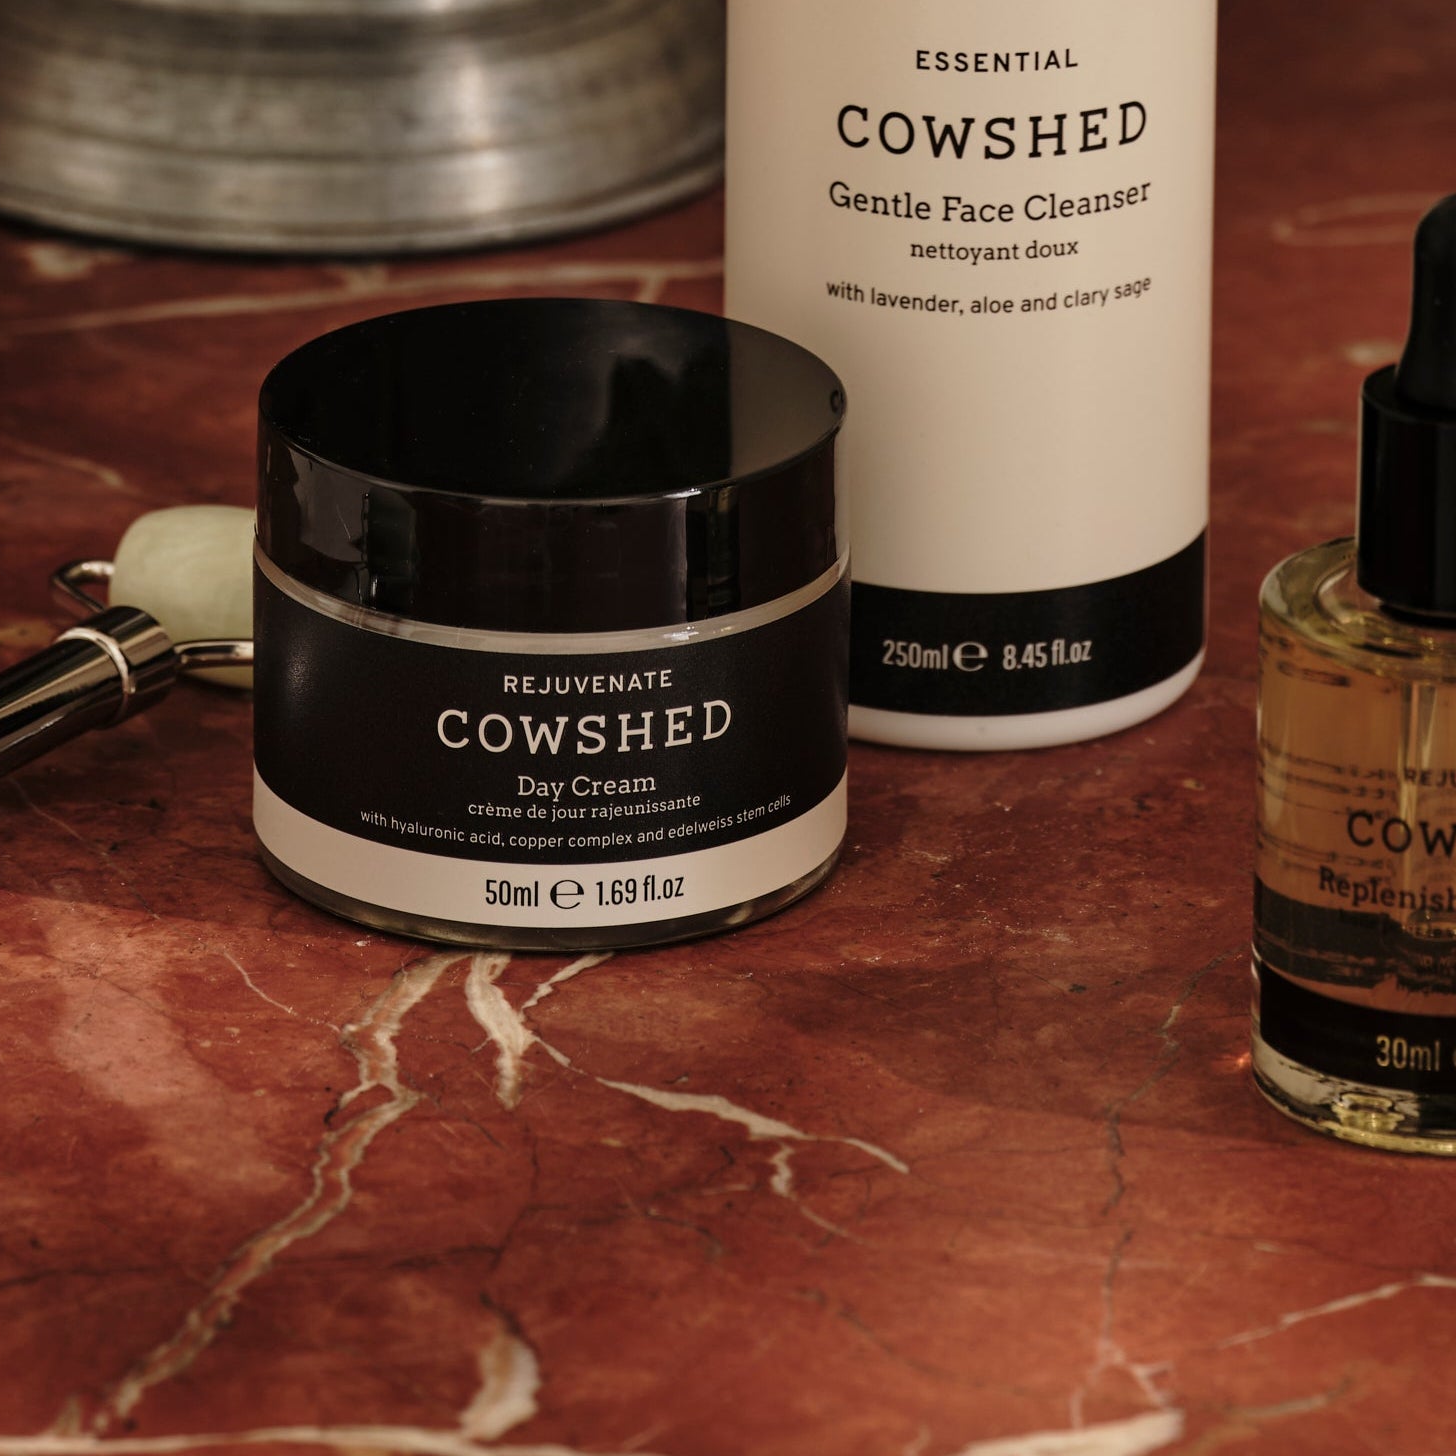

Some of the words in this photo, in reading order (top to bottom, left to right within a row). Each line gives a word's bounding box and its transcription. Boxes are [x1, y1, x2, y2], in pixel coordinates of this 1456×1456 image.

[916, 49, 1078, 73] ESSENTIAL
[837, 100, 1147, 160] COWSHED
[829, 181, 931, 220] Gentle
[942, 196, 1014, 222] Face
[1024, 182, 1151, 220] Cleanser
[910, 242, 1019, 265] nettoyant
[1025, 240, 1079, 259] doux
[826, 281, 864, 303] with
[871, 289, 964, 315] lavender,
[971, 297, 1013, 314] aloe
[1021, 294, 1056, 312] and
[1064, 288, 1109, 308] clary
[1115, 276, 1151, 298] sage
[882, 639, 948, 670] 250ml
[1003, 641, 1047, 670] 8.45
[1052, 639, 1092, 666] fl.oz
[504, 669, 673, 694] REJUVENATE
[437, 699, 732, 755] COWSHED
[518, 777, 565, 801] Day
[572, 775, 656, 796] Cream
[360, 810, 388, 828] with
[391, 817, 464, 841] hyaluronic
[470, 828, 505, 848] acid,
[509, 831, 564, 851] copper
[568, 831, 633, 850] complex
[637, 826, 664, 843] and
[668, 815, 733, 839] edelweiss
[736, 808, 766, 826] stem
[768, 793, 791, 816] cells
[467, 802, 522, 818] crème
[527, 803, 547, 819] de
[550, 804, 587, 822] jour
[591, 794, 701, 821] rajeunissante
[485, 879, 539, 908] 50ml
[596, 879, 637, 907] 1.69
[643, 876, 684, 902] fl.oz
[1376, 1036, 1440, 1071] 30ml
